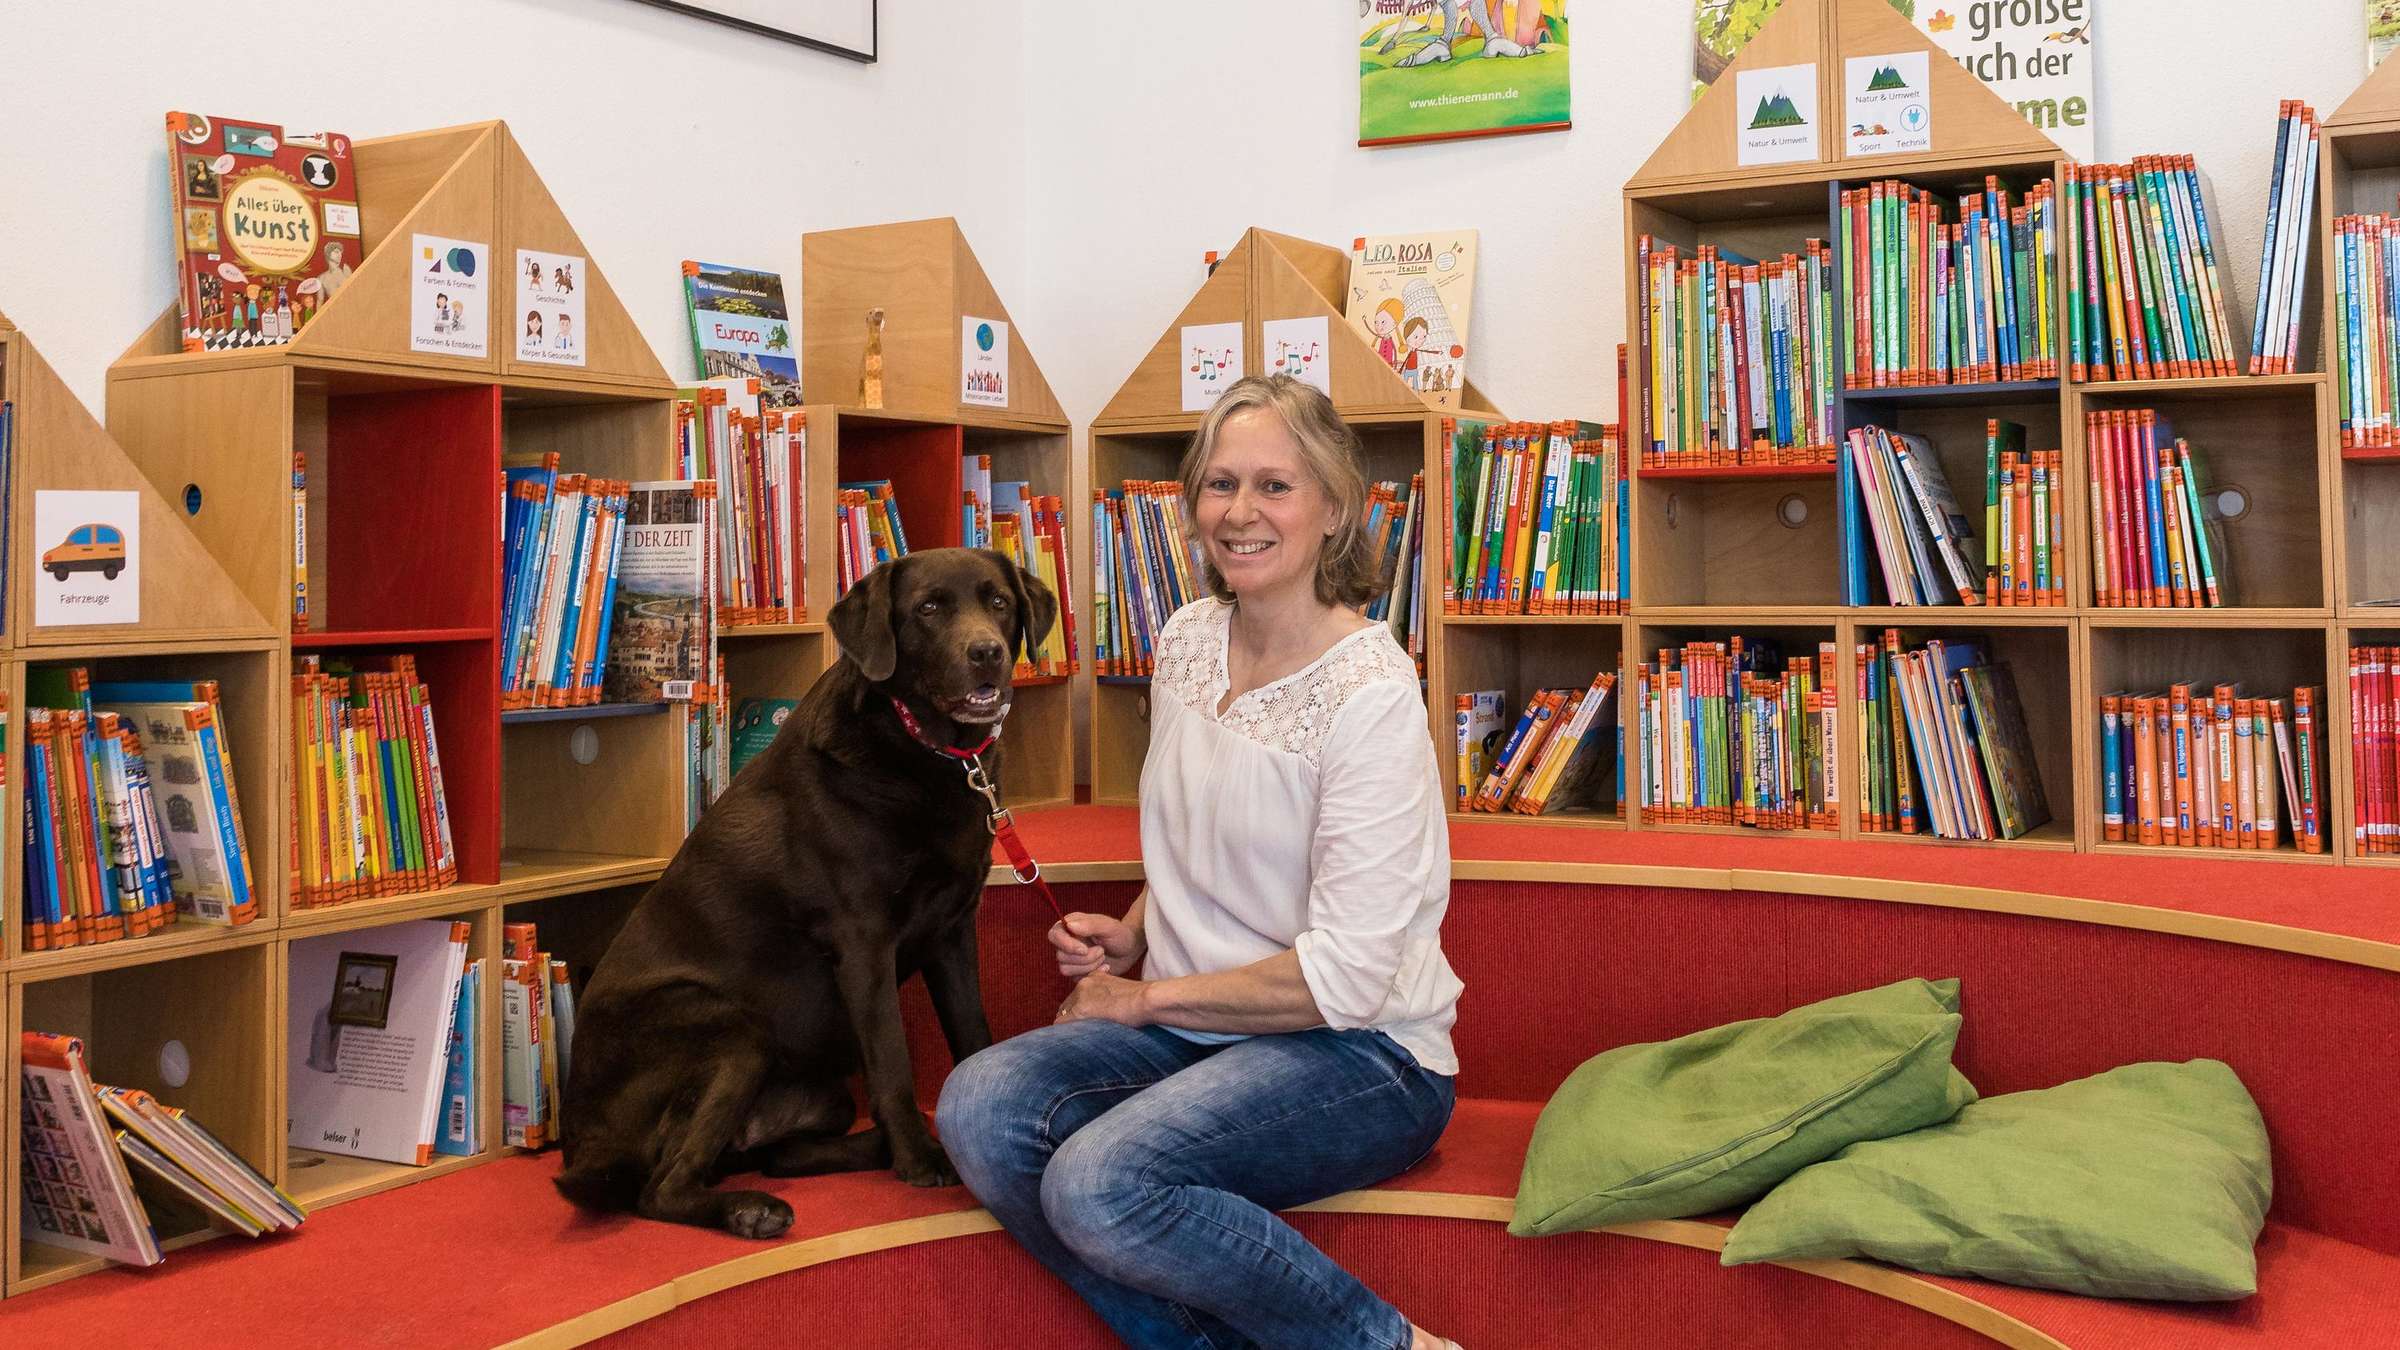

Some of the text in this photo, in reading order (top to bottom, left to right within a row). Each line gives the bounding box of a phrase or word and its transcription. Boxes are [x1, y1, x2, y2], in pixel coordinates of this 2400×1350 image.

[1955, 42, 2073, 82] uch der
[1409, 87, 1519, 110] www.thienemann.de
[1855, 90, 1920, 103] Natur & Umwelt
[1748, 136, 1808, 149] Natur & Umwelt
[1859, 143, 1880, 152] Sport
[1896, 138, 1927, 148] Technik
[237, 197, 303, 214] Alles über
[234, 212, 310, 242] Kunst
[1398, 242, 1433, 262] ROSA
[1398, 265, 1427, 273] Italien
[423, 276, 446, 285] Farben
[453, 280, 477, 289] Formen
[535, 294, 566, 304] Geschichte
[715, 323, 760, 347] Europa
[416, 336, 444, 346] Forschen
[451, 340, 482, 350] Entdecken
[521, 350, 540, 359] Körper
[1825, 348, 1833, 375] machen
[1825, 376, 1833, 387] Was
[1203, 388, 1222, 396] Musik
[1545, 492, 1553, 509] Meer
[635, 530, 693, 547] DER ZEIT
[60, 594, 110, 605] Fahrzeuge
[2177, 733, 2185, 765] Vogelnest
[2162, 762, 2170, 786] Nilpferd
[2257, 765, 2265, 790] Papagei
[226, 828, 236, 858] Stephen
[323, 1130, 346, 1143] belser
